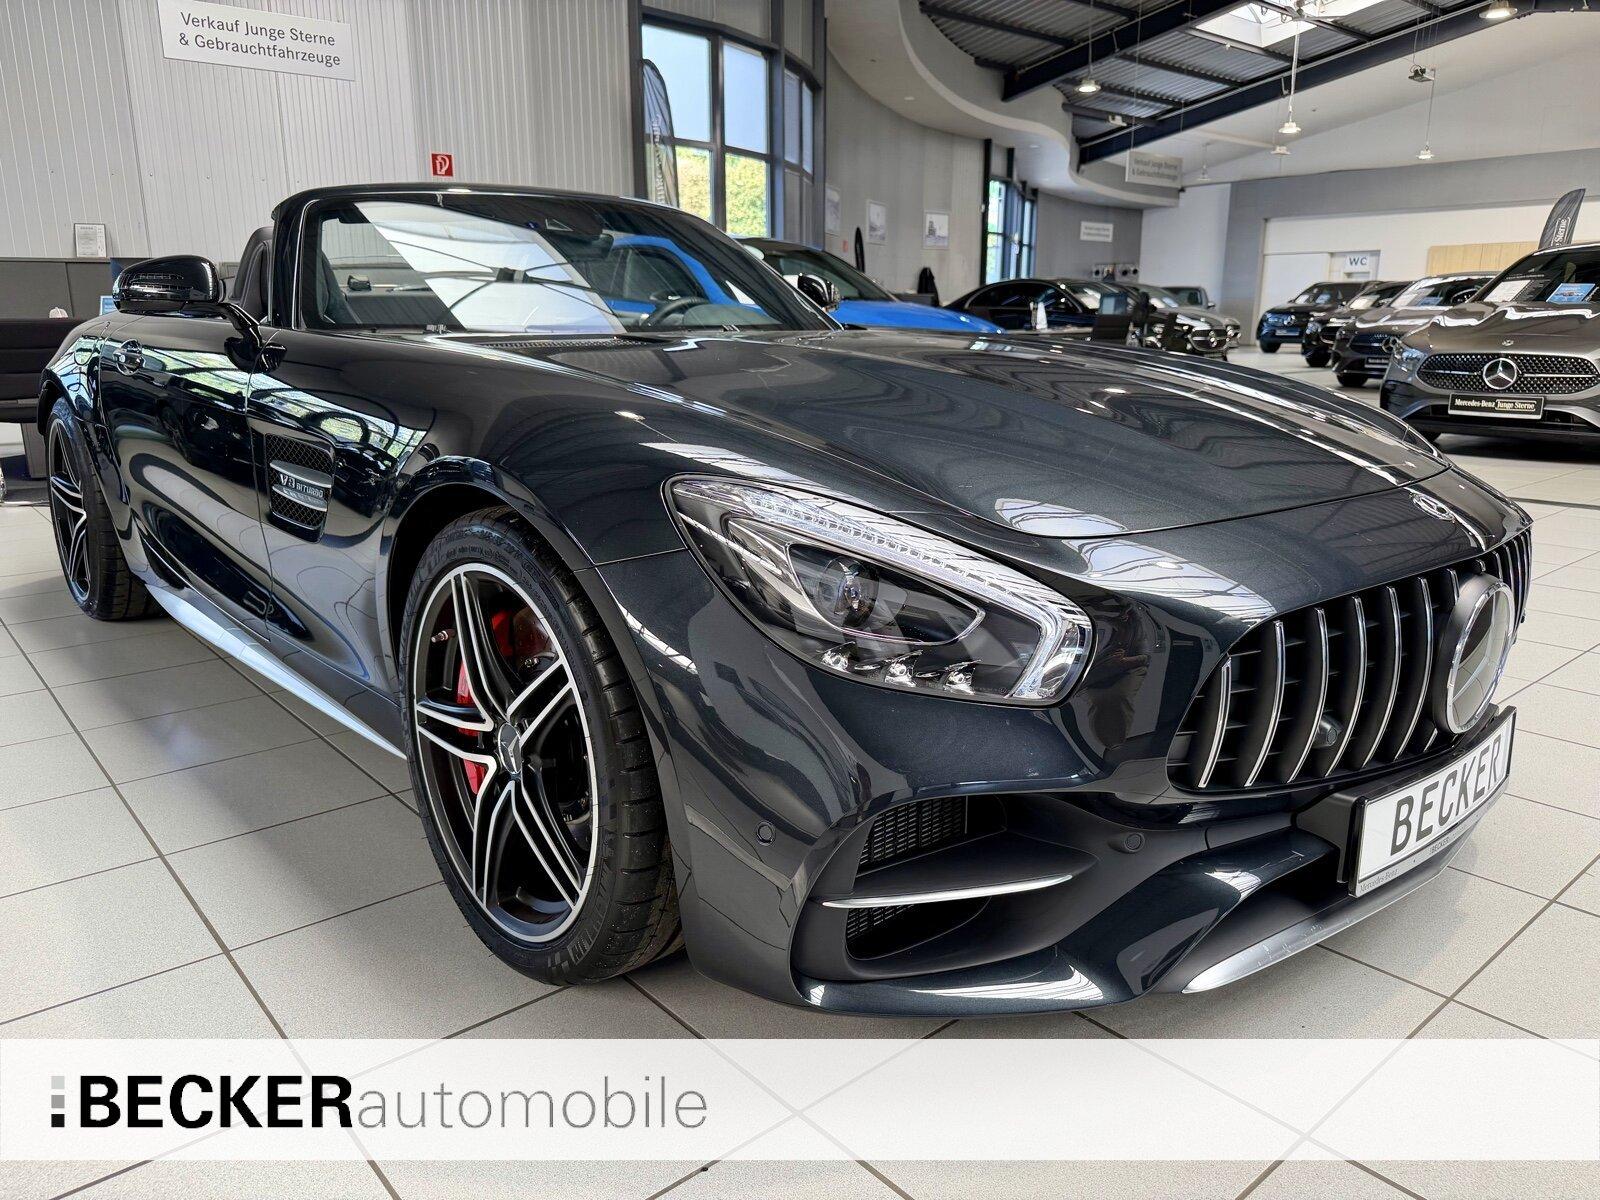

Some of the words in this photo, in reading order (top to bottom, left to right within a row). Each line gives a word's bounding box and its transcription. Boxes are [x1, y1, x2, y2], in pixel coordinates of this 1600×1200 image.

[180, 12, 240, 33] Verkauf
[244, 22, 285, 41] Junge
[289, 28, 335, 46] Sterne
[179, 32, 189, 46] &
[194, 34, 341, 68] Gebrauchtfahrzeuge
[1554, 219, 1567, 245] Sterne
[1349, 256, 1367, 266] WC
[1454, 398, 1495, 408] Mercedes-Benz
[1497, 401, 1514, 410] Junge
[1514, 401, 1535, 410] Sterne
[1390, 733, 1502, 857] BECKER
